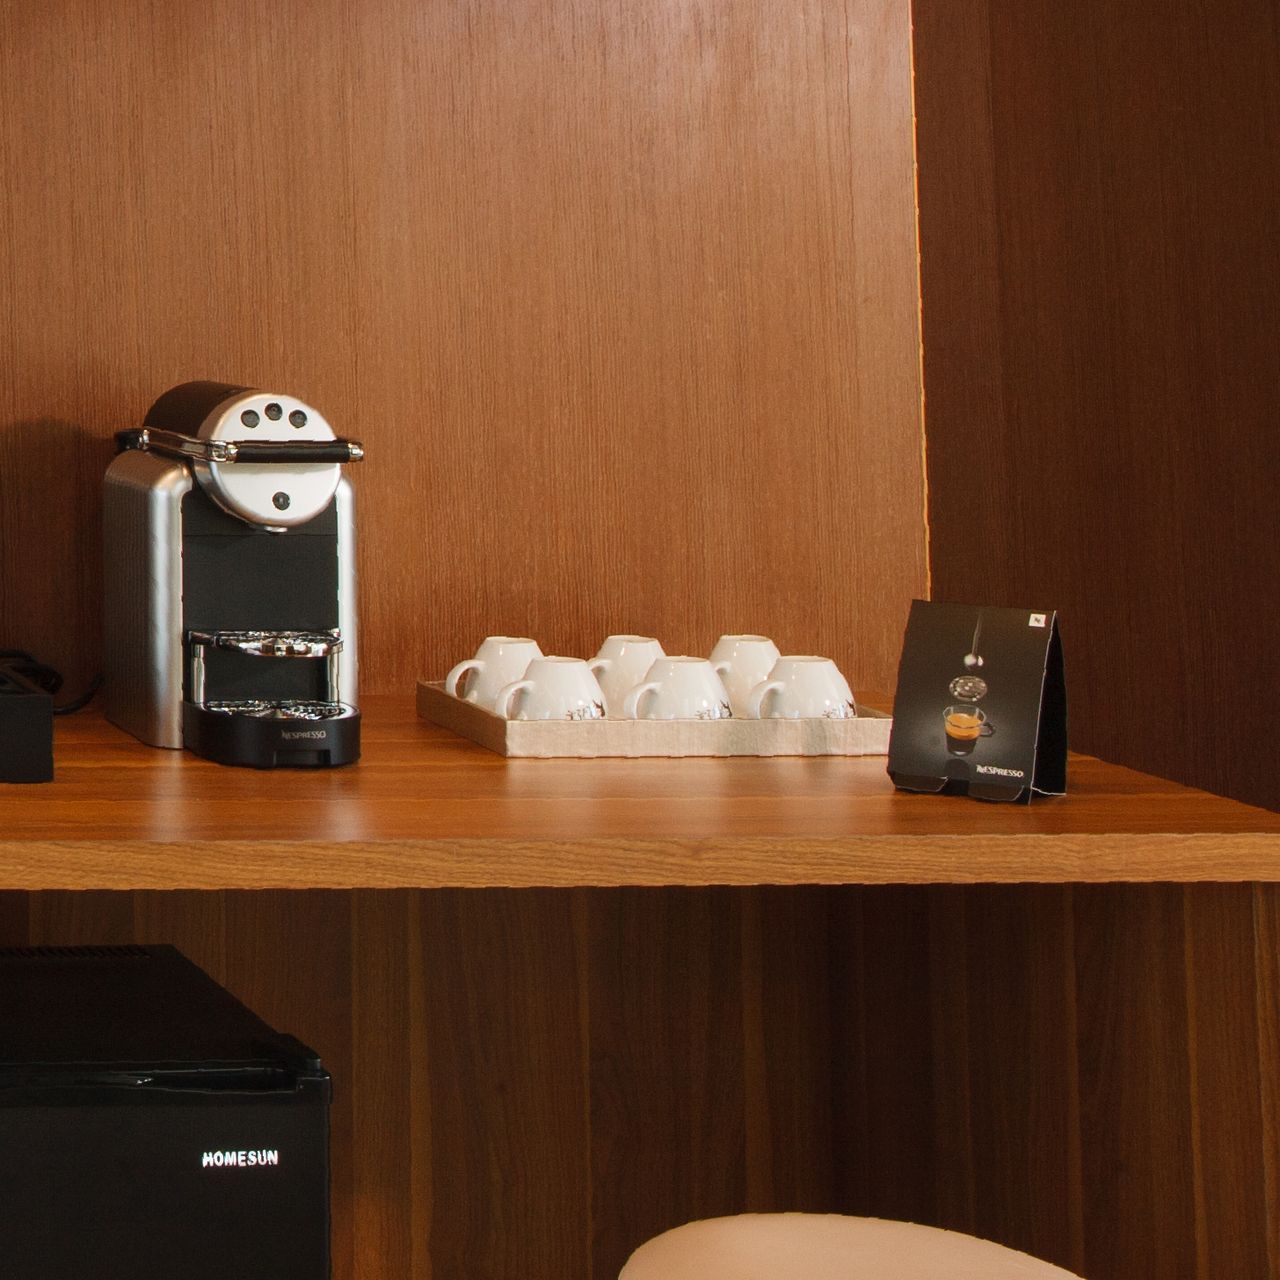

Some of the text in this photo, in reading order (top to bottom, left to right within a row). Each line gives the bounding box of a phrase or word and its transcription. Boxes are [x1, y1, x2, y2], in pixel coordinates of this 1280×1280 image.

[281, 729, 327, 740] NESPRESSO
[976, 764, 1024, 778] NESPRESSO
[202, 1149, 279, 1168] HOMESUN
